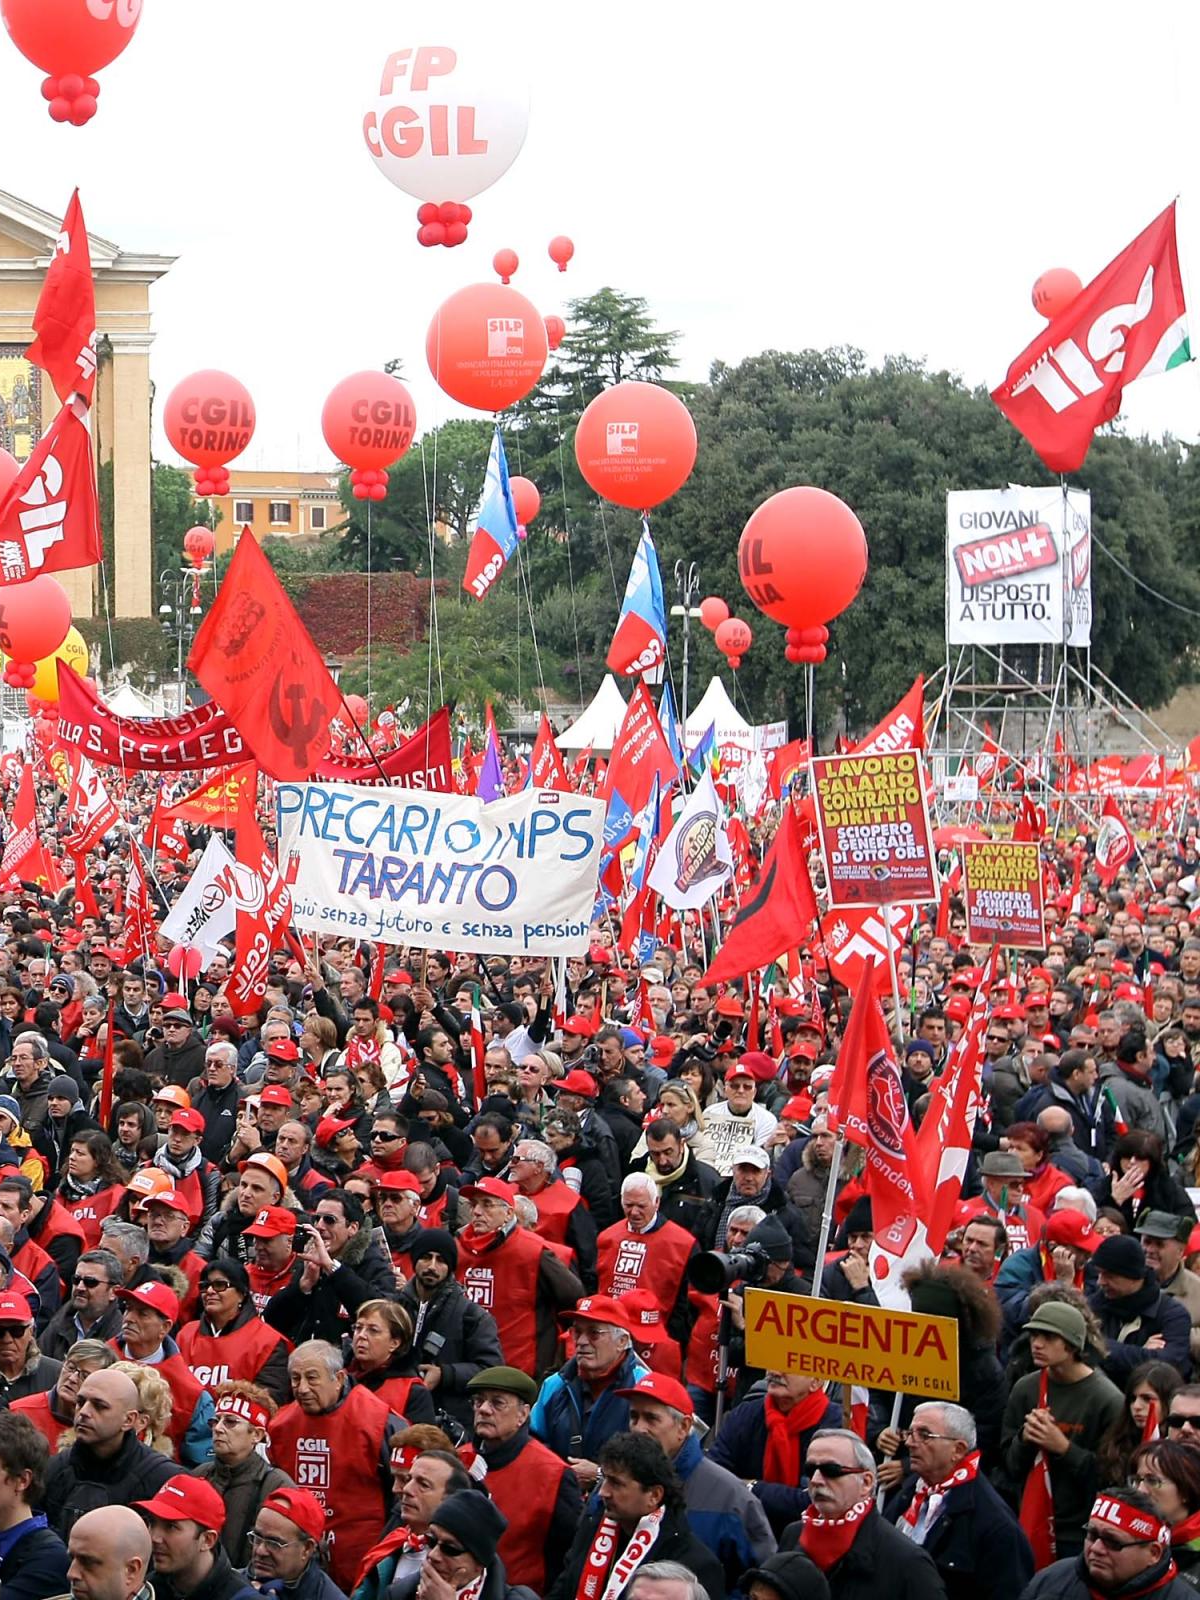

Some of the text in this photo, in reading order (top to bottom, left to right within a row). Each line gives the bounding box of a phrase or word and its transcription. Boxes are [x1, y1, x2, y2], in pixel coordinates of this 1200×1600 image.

[380, 46, 457, 96] FP
[363, 105, 489, 158] CGIL
[488, 321, 523, 332] SILP
[182, 399, 253, 428] CGIL
[351, 399, 413, 428] CGIL
[349, 428, 410, 450] TORINO
[607, 425, 638, 434] SILP
[178, 428, 250, 452] TORINO
[959, 510, 1040, 530] GIOVANI
[961, 531, 1047, 577] NON+
[960, 583, 1051, 603] DISPOSTI
[959, 602, 1052, 622] A TUTTO.
[824, 754, 916, 779] LAVORO
[817, 772, 915, 795] SALARIO
[822, 786, 920, 811] CONTRATTO
[276, 785, 442, 856] PRECARI
[824, 804, 908, 828] DIRITTI
[836, 821, 913, 840] SCIOPERO
[837, 833, 916, 852] GENERALE
[971, 843, 1037, 858] LAVORO
[831, 845, 926, 865] DI OTTO ORE
[965, 854, 1037, 868] SALARIO
[333, 848, 518, 912] TARANTO
[967, 866, 1039, 880] CONTRATTO
[968, 878, 1028, 891] DIRITTI
[976, 890, 1031, 901] SCIOPERO
[976, 898, 1033, 909] GENERALE
[293, 898, 317, 917] più
[320, 904, 368, 927] senza
[370, 907, 433, 937] futuro
[441, 923, 451, 935] e
[461, 921, 513, 938] senza
[970, 906, 1039, 919] DI OTTO ORE
[619, 1240, 647, 1253] CGIL
[465, 1267, 494, 1279] CGIL
[617, 1259, 639, 1274] SPI
[466, 1287, 491, 1305] SPI
[755, 1299, 949, 1361] ARGENTA
[787, 1351, 895, 1387] FERRARA
[901, 1374, 919, 1387] SPI
[296, 1438, 331, 1453] CGIL
[298, 1462, 327, 1485] SPI
